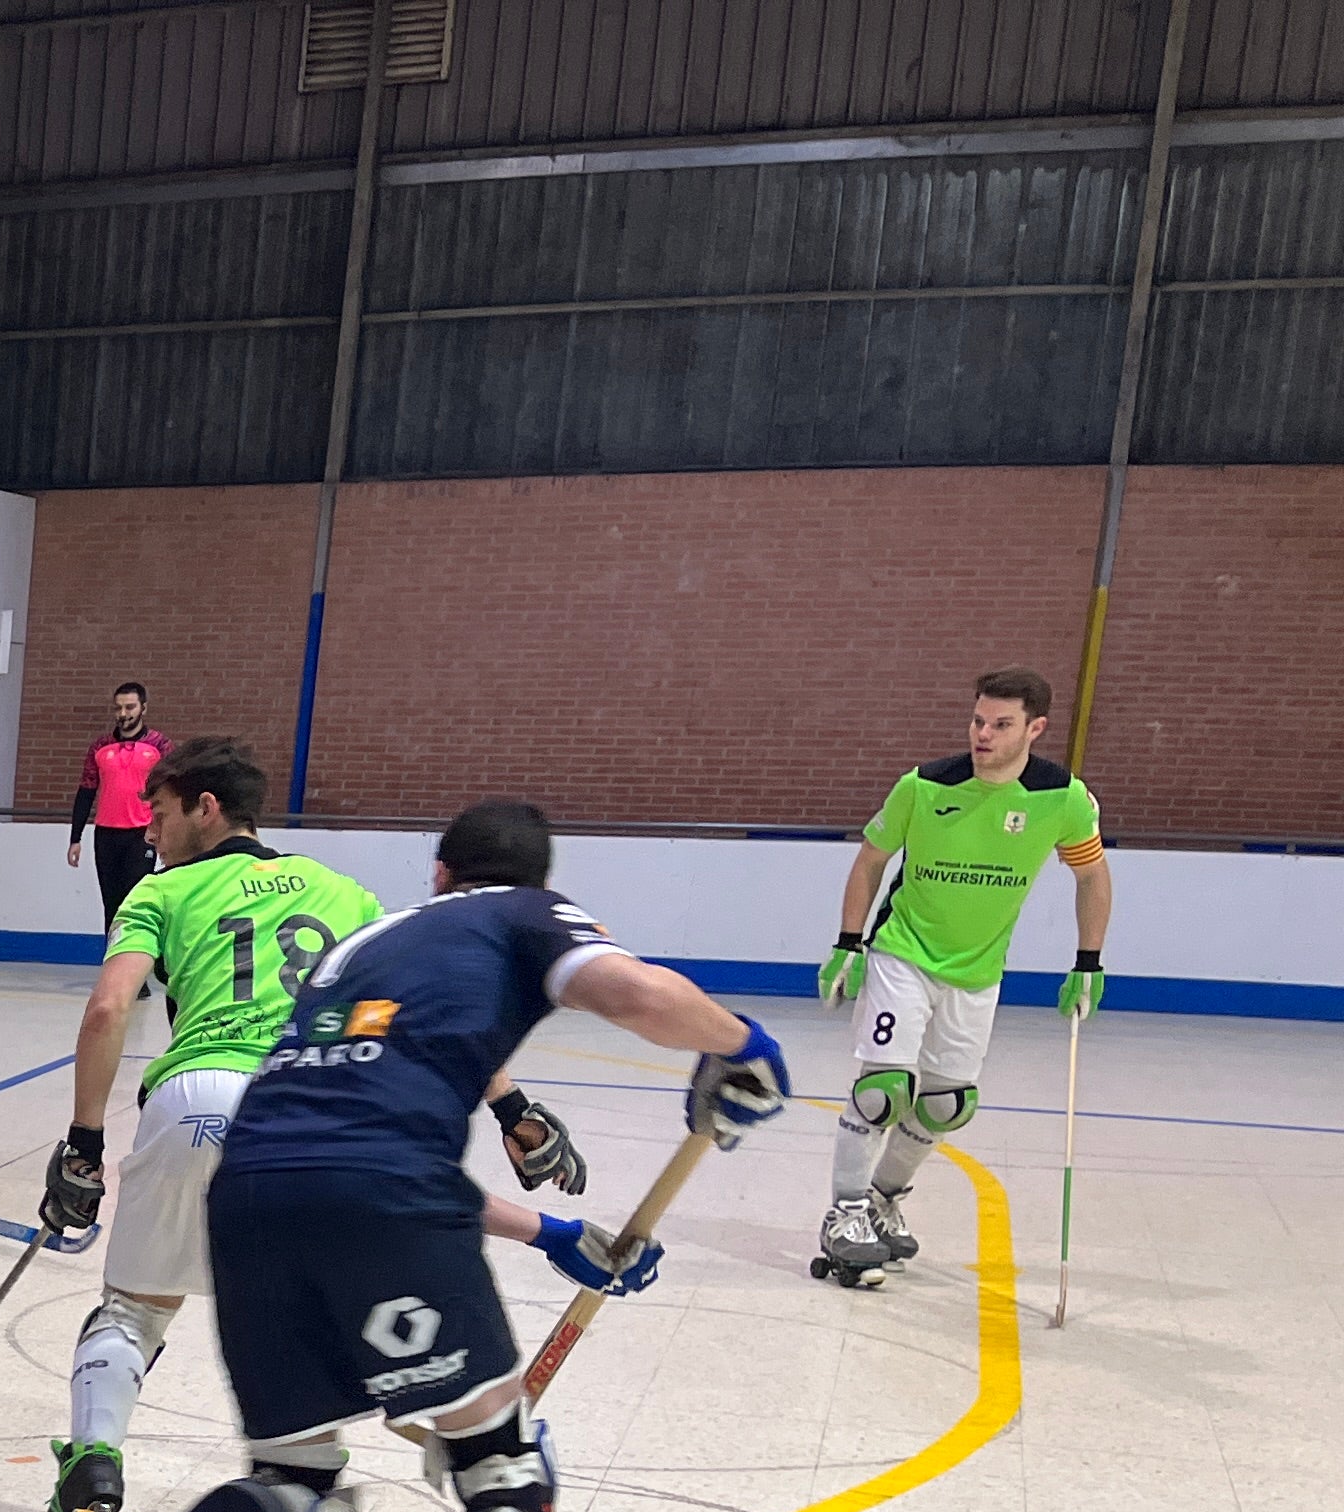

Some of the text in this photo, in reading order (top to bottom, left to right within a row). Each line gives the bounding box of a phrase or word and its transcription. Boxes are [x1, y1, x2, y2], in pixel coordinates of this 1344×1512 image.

[241, 874, 307, 898] HUGO
[915, 864, 1028, 887] UNIVERSITARIA
[218, 913, 338, 1003] 18
[872, 1011, 896, 1046] 8
